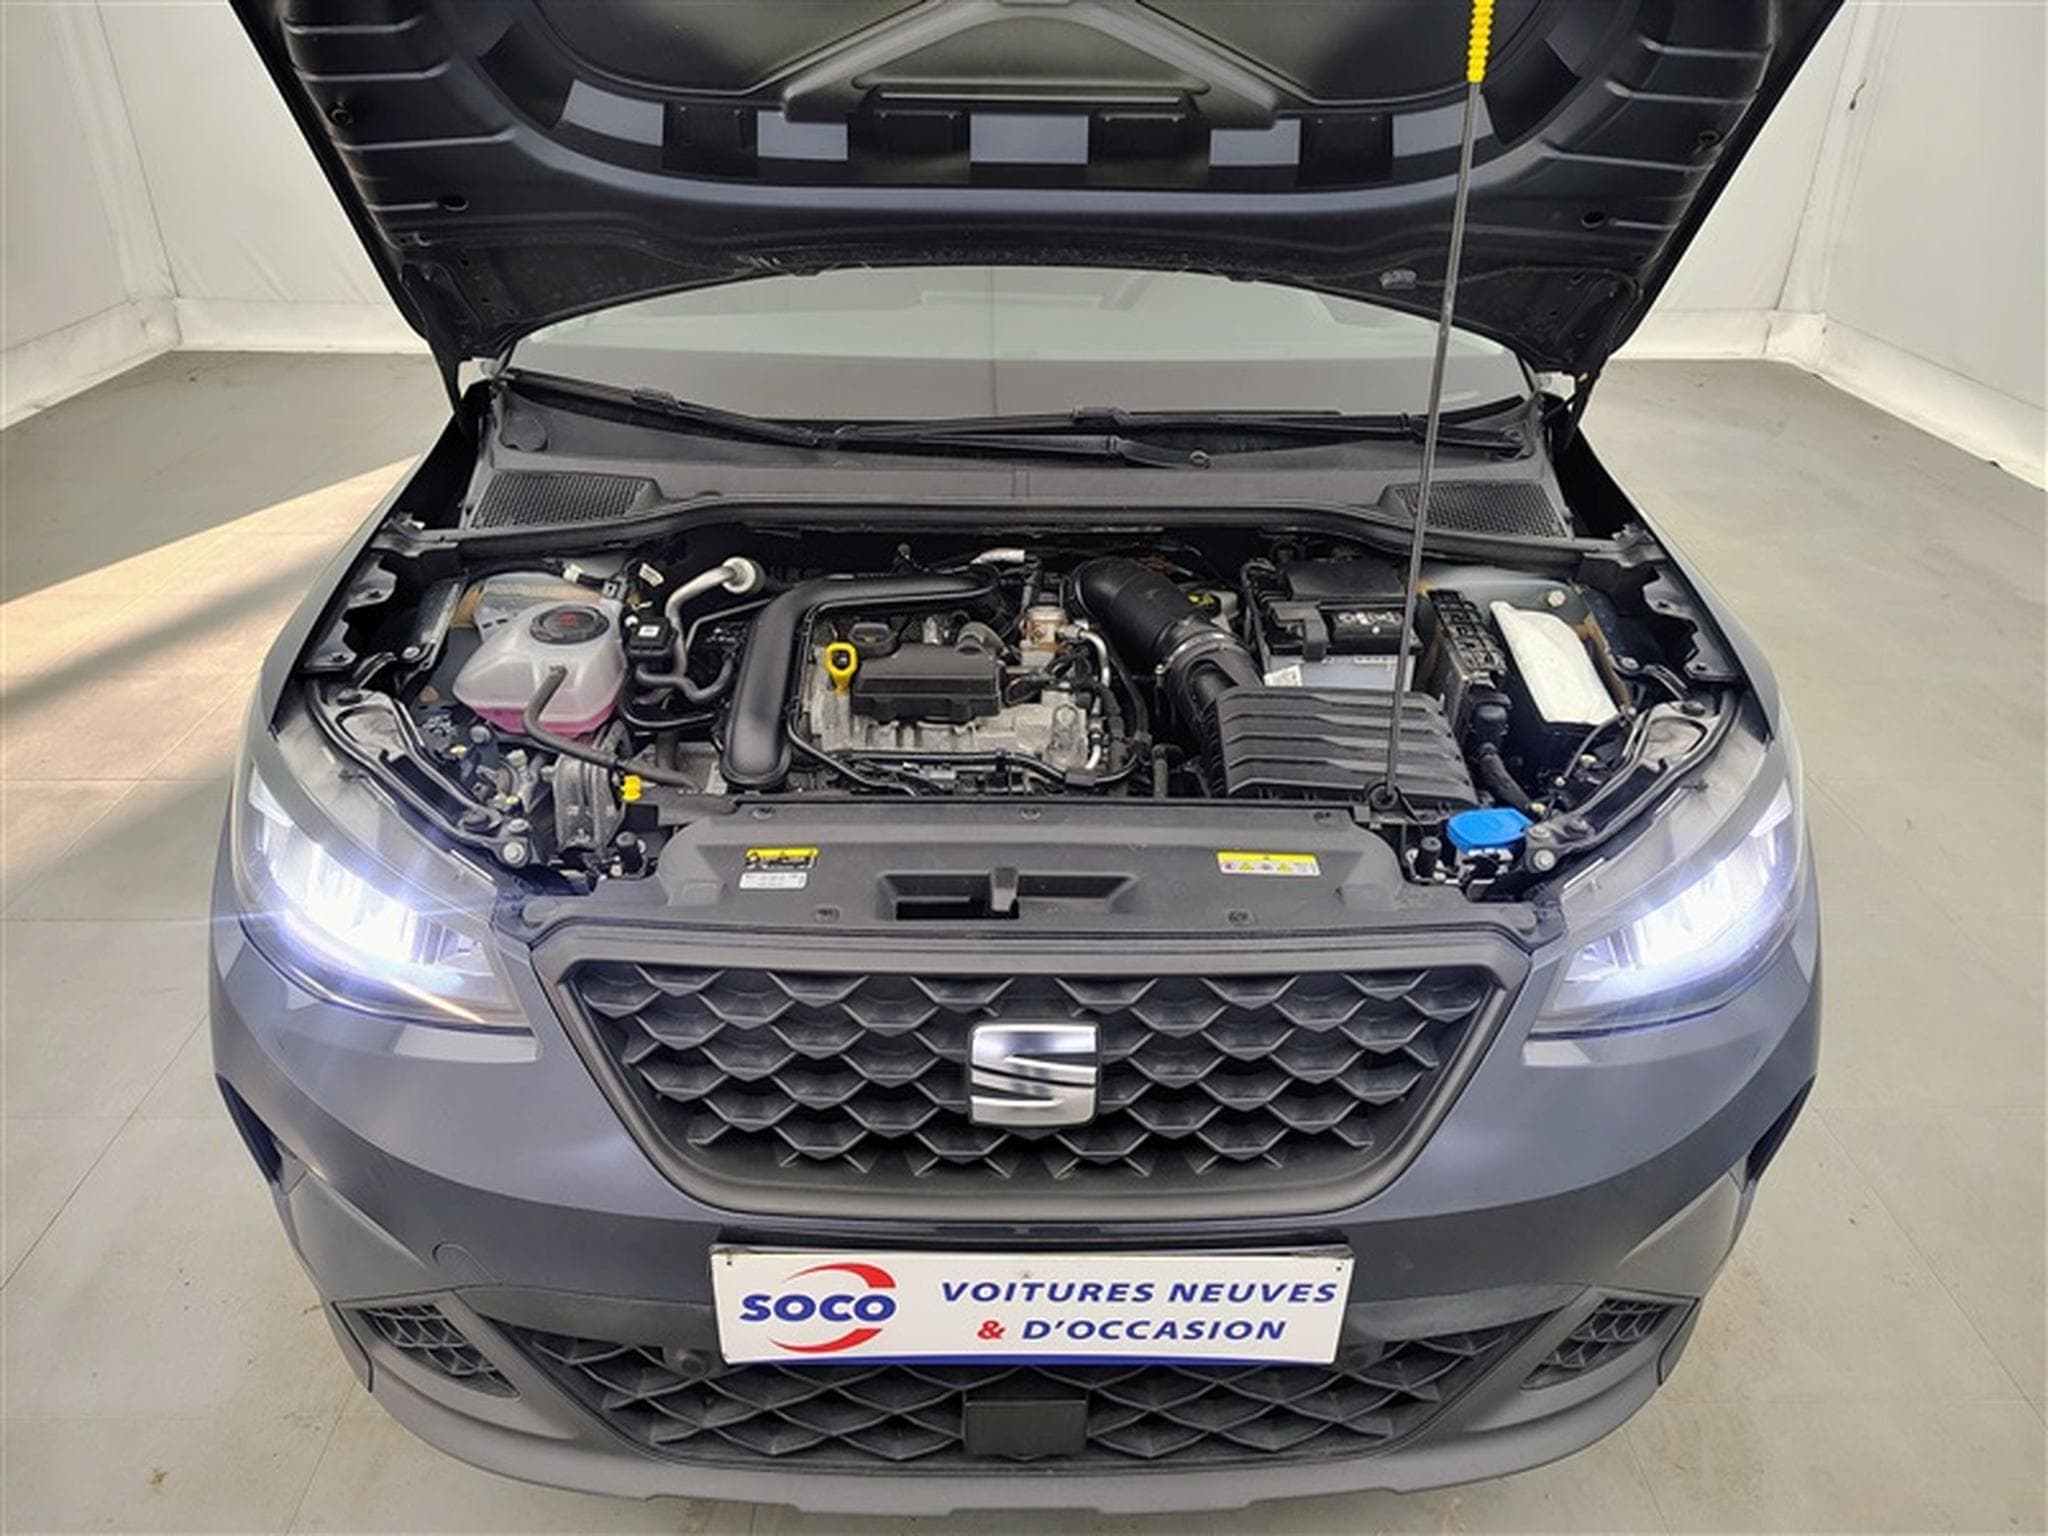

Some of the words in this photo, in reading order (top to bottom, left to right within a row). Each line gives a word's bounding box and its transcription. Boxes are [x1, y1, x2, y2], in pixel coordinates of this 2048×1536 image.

[941, 1281, 1155, 1303] VOITURES
[1168, 1282, 1337, 1303] NEUVES
[739, 1293, 897, 1322] SOCO
[976, 1319, 1006, 1341] &
[1021, 1319, 1287, 1341] D'OCCASION
